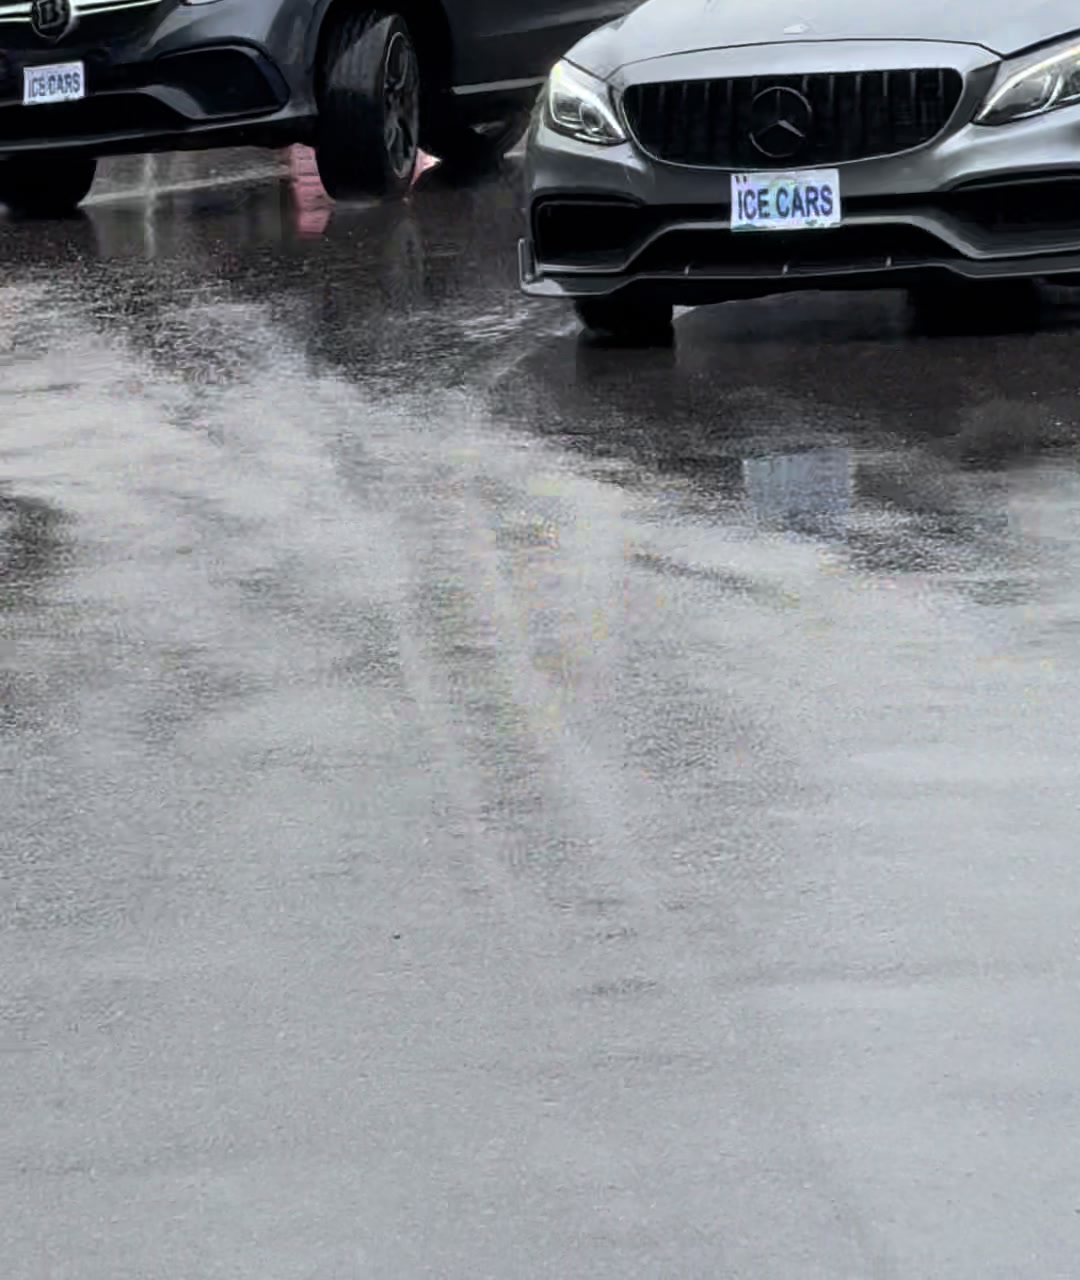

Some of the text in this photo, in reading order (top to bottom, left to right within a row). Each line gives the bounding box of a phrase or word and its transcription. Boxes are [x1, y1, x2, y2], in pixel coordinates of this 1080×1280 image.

[48, 71, 81, 95] CARS
[737, 184, 833, 221] ICE CARS
